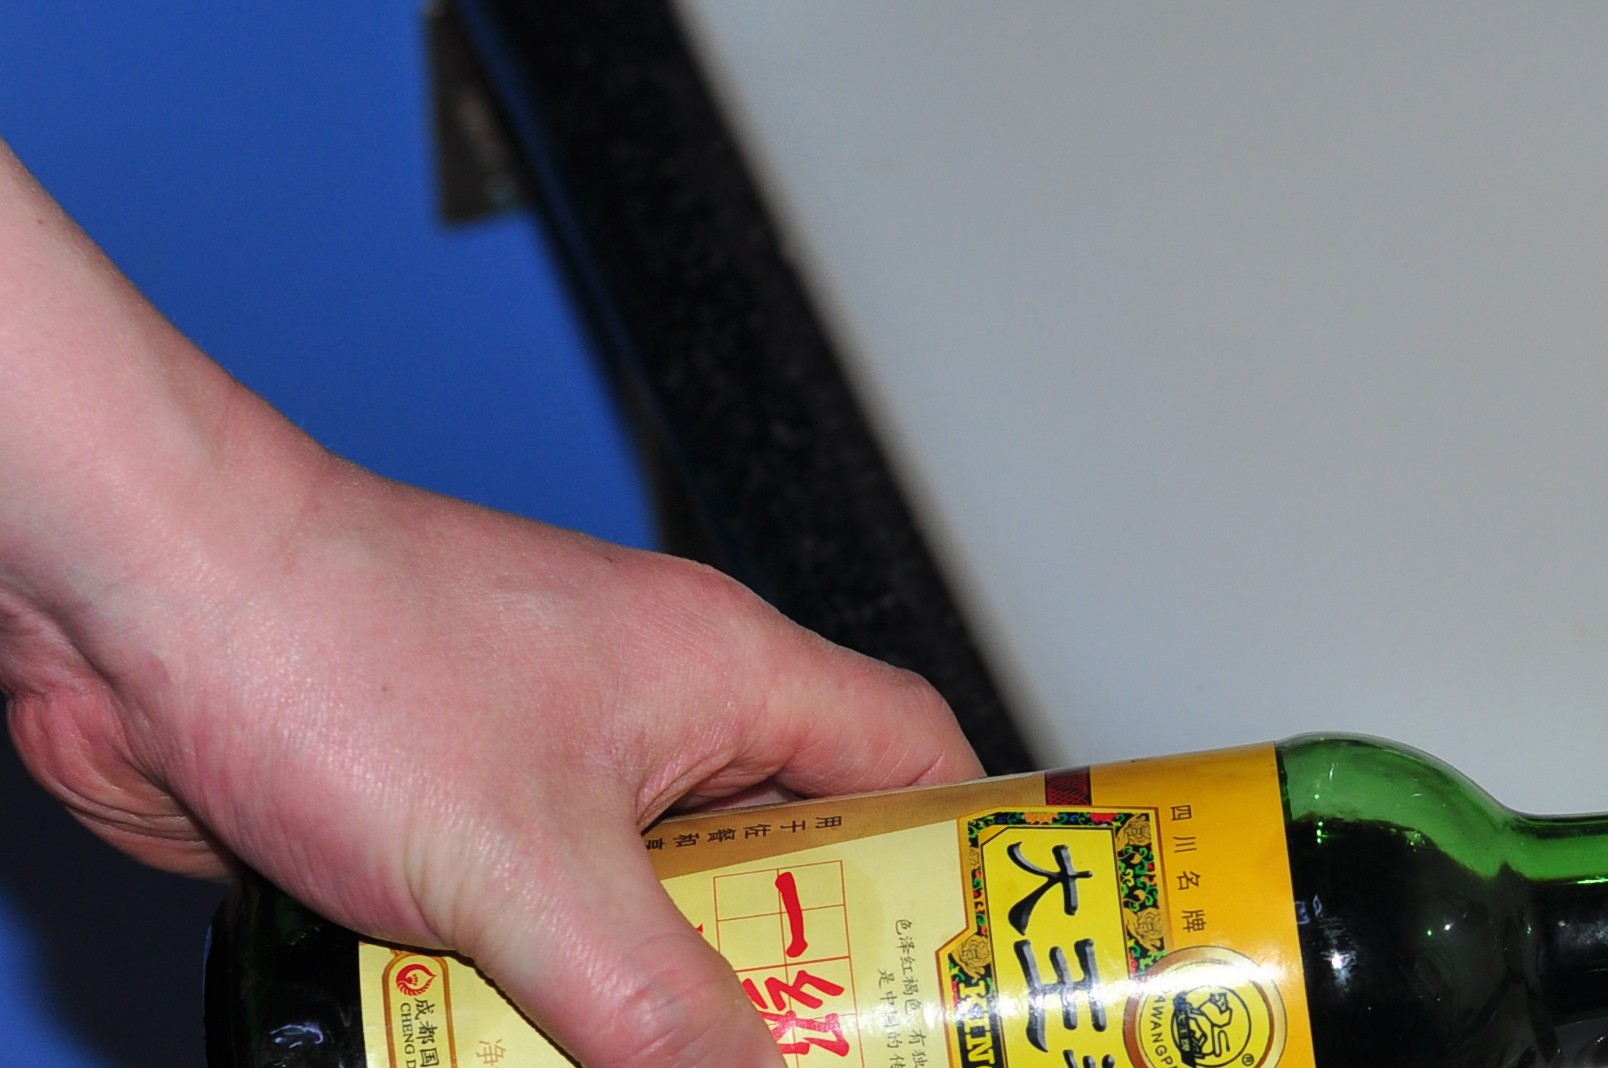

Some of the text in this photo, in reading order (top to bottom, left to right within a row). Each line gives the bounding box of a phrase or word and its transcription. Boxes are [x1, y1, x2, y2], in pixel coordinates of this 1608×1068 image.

[1170, 804, 1207, 933] 四川名牌
[399, 1002, 416, 1056] CHENG
